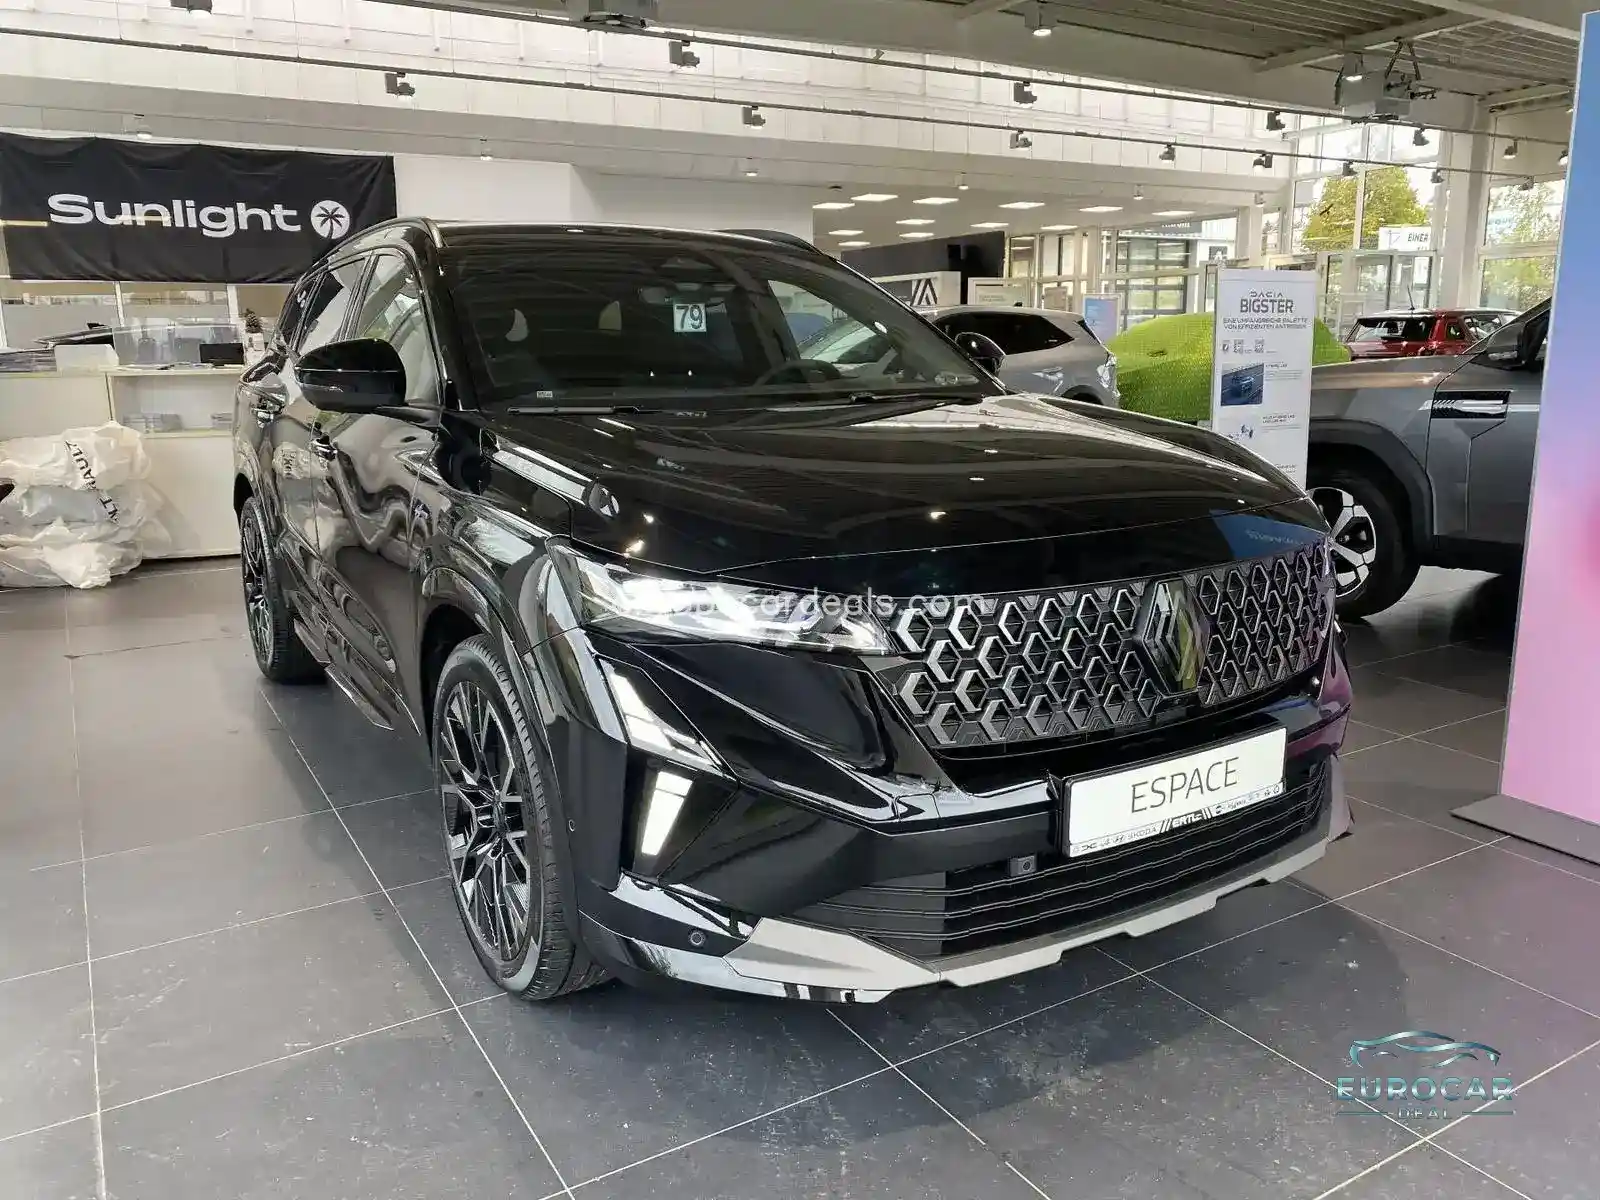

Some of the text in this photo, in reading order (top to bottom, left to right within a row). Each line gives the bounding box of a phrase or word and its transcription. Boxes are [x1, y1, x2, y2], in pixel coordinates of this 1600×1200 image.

[48, 193, 301, 237] Sunlight
[675, 305, 704, 329] 79
[1240, 299, 1294, 313] BIGSTER
[1131, 756, 1239, 813] ESPACE
